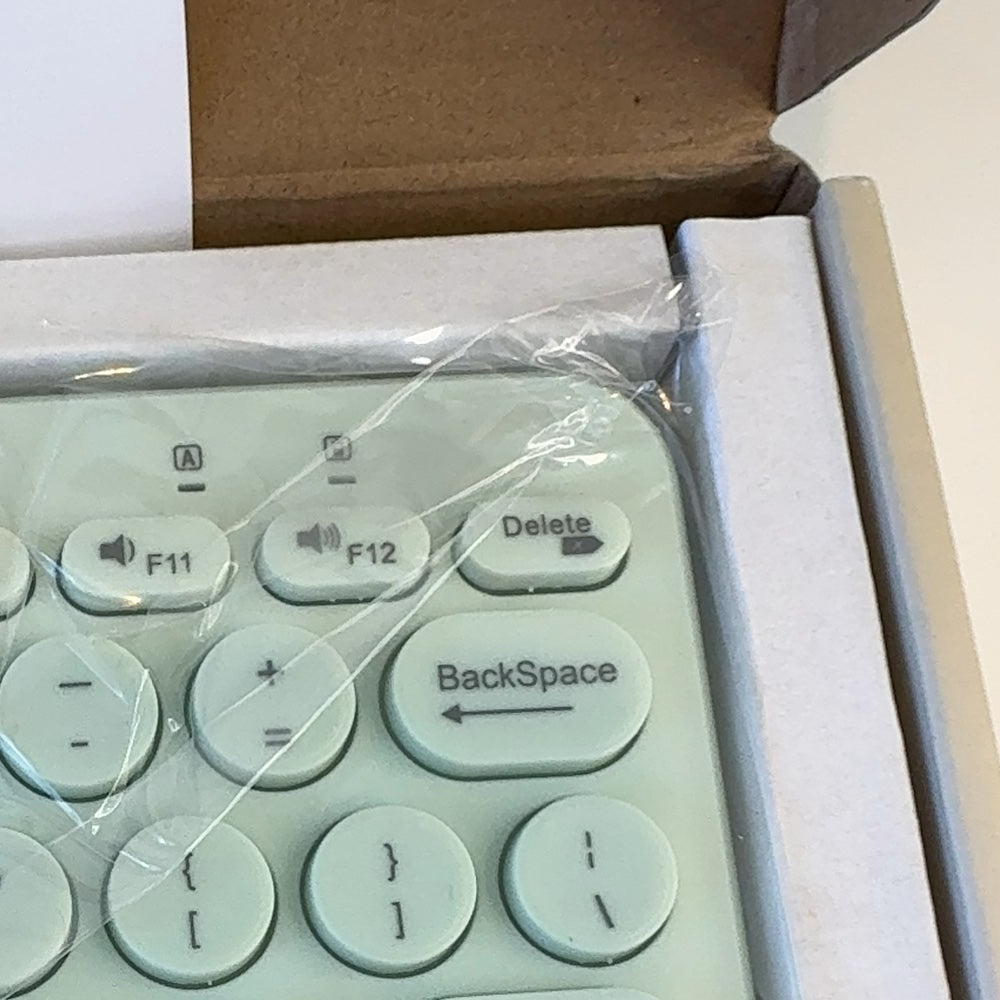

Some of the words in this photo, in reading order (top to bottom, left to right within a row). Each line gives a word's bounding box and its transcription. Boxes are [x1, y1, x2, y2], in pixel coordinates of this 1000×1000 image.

[502, 514, 592, 537] Delete
[147, 552, 193, 575] F11
[347, 542, 397, 565] F12
[437, 660, 619, 692] BackSpace
